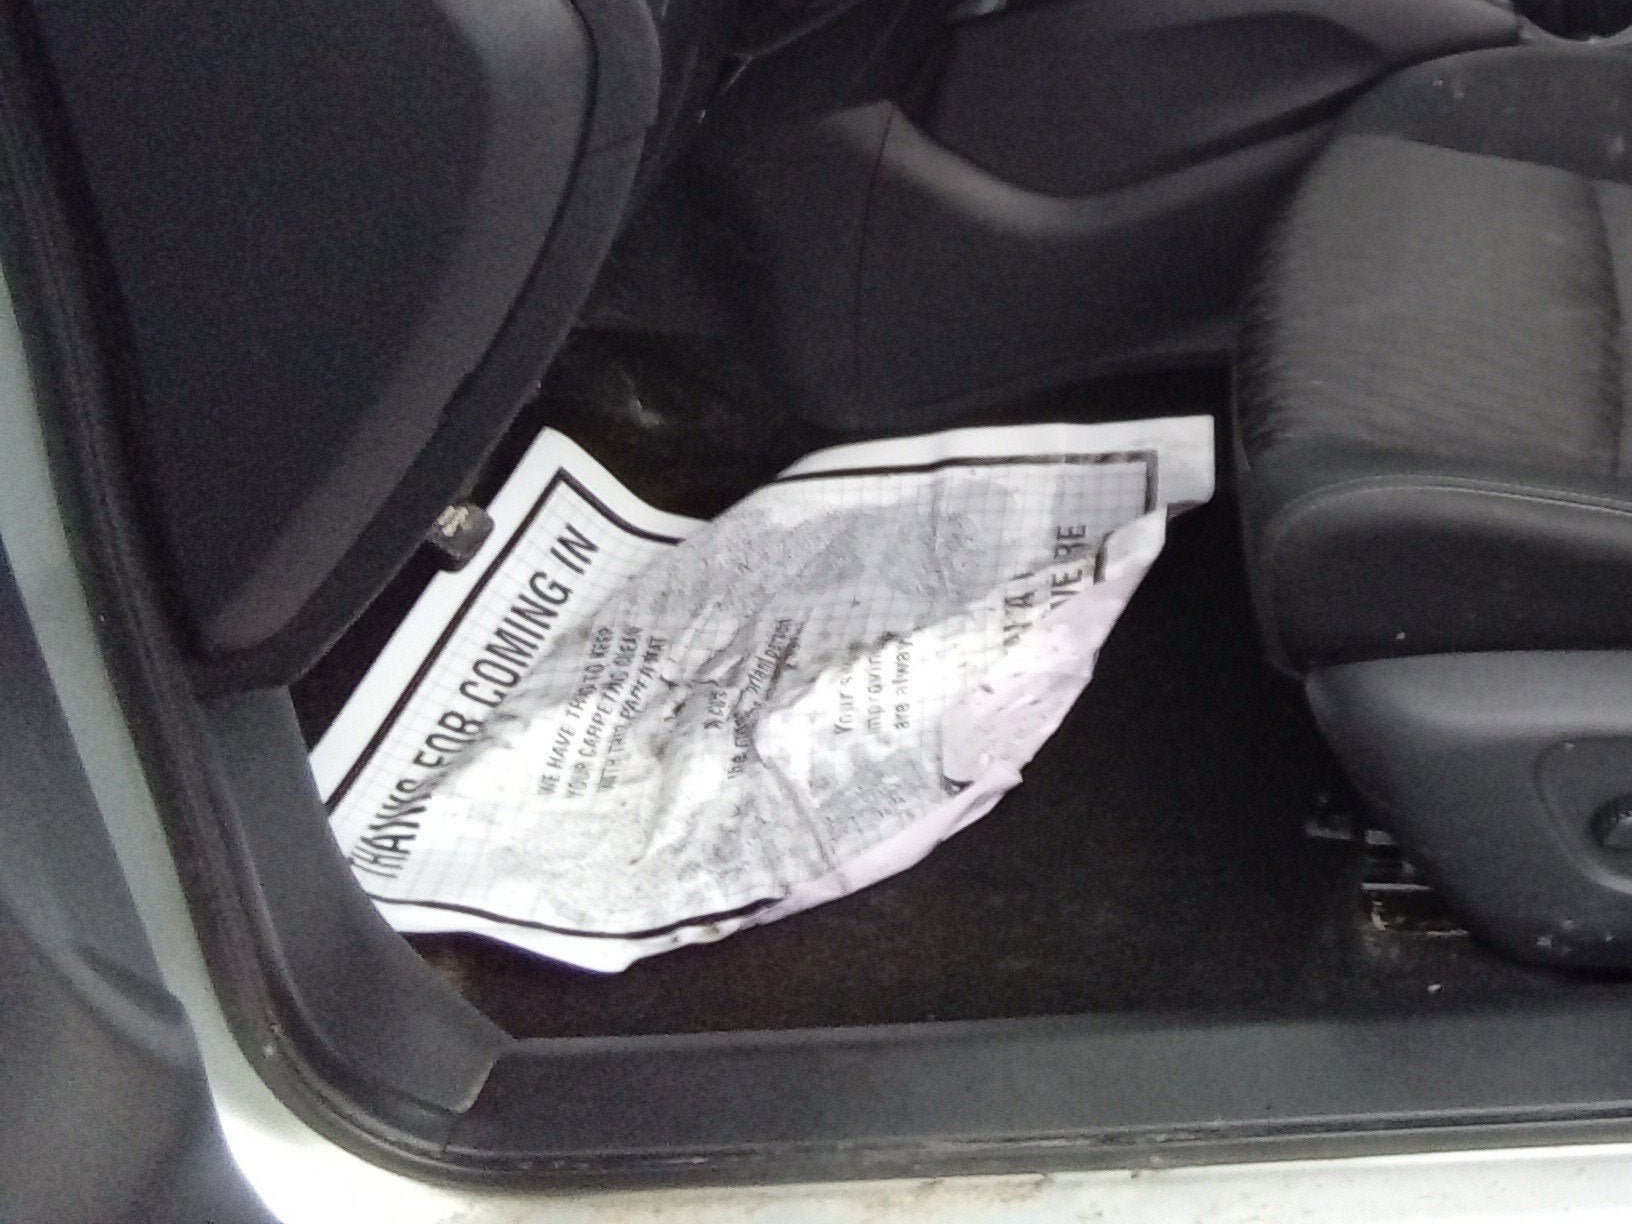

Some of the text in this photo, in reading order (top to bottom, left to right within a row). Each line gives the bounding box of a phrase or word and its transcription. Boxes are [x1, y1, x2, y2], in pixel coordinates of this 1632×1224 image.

[413, 710, 485, 769] FOR
[459, 571, 573, 707] COMING
[550, 522, 600, 576] IN
[834, 693, 853, 735] Your
[547, 726, 575, 769] HAVE
